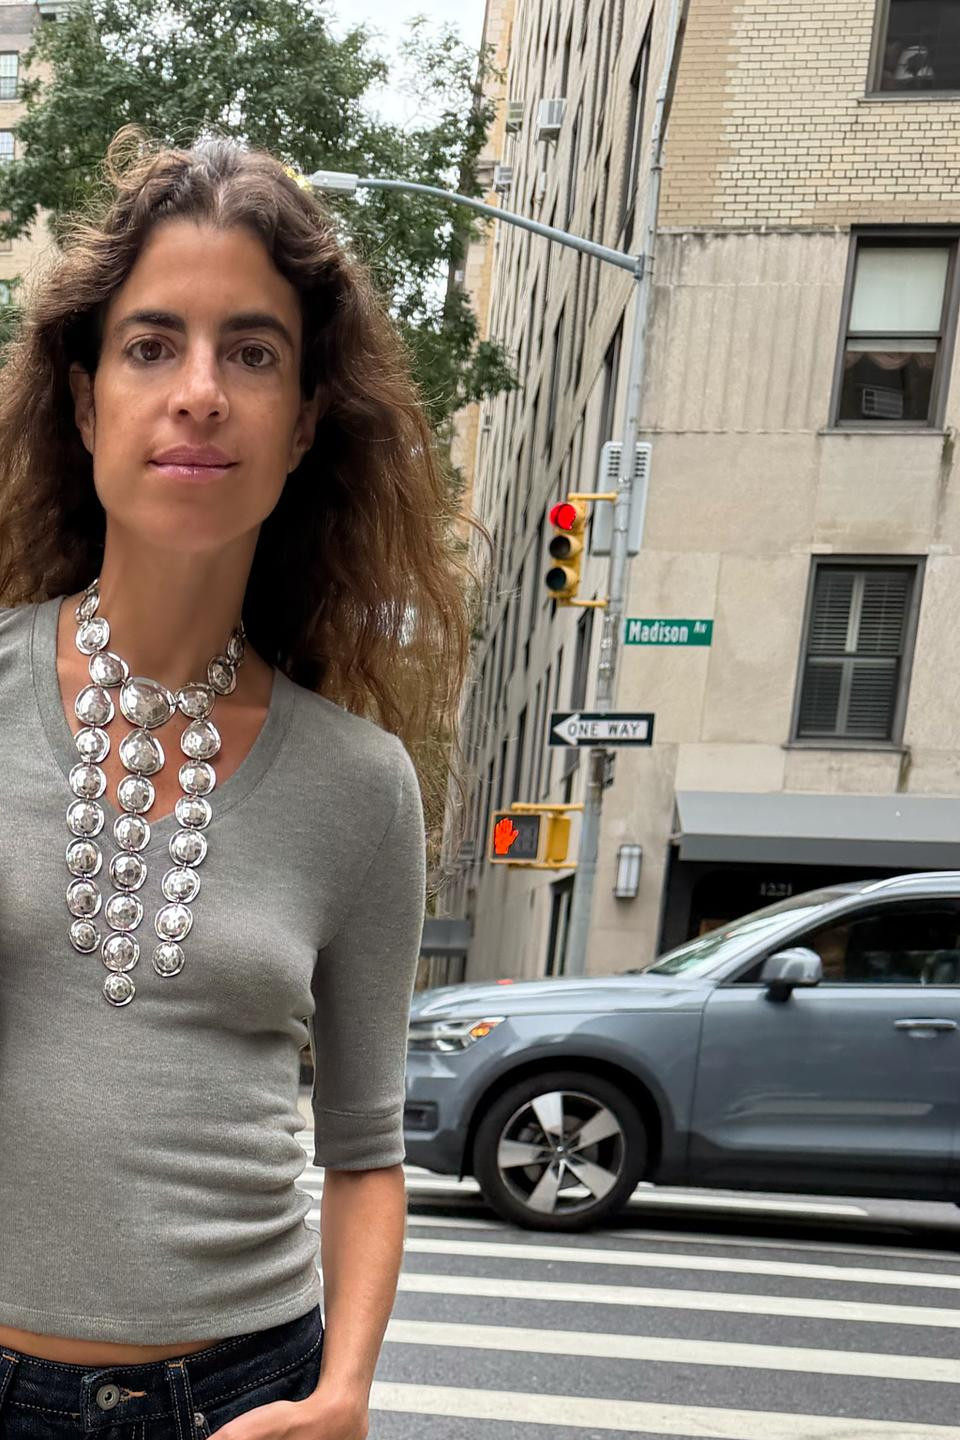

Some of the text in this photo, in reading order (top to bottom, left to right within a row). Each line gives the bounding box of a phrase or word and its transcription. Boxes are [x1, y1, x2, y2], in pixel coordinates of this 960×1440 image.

[628, 621, 688, 642] Madison
[567, 723, 639, 736] ONE WAY
[760, 882, 792, 896] 1221
